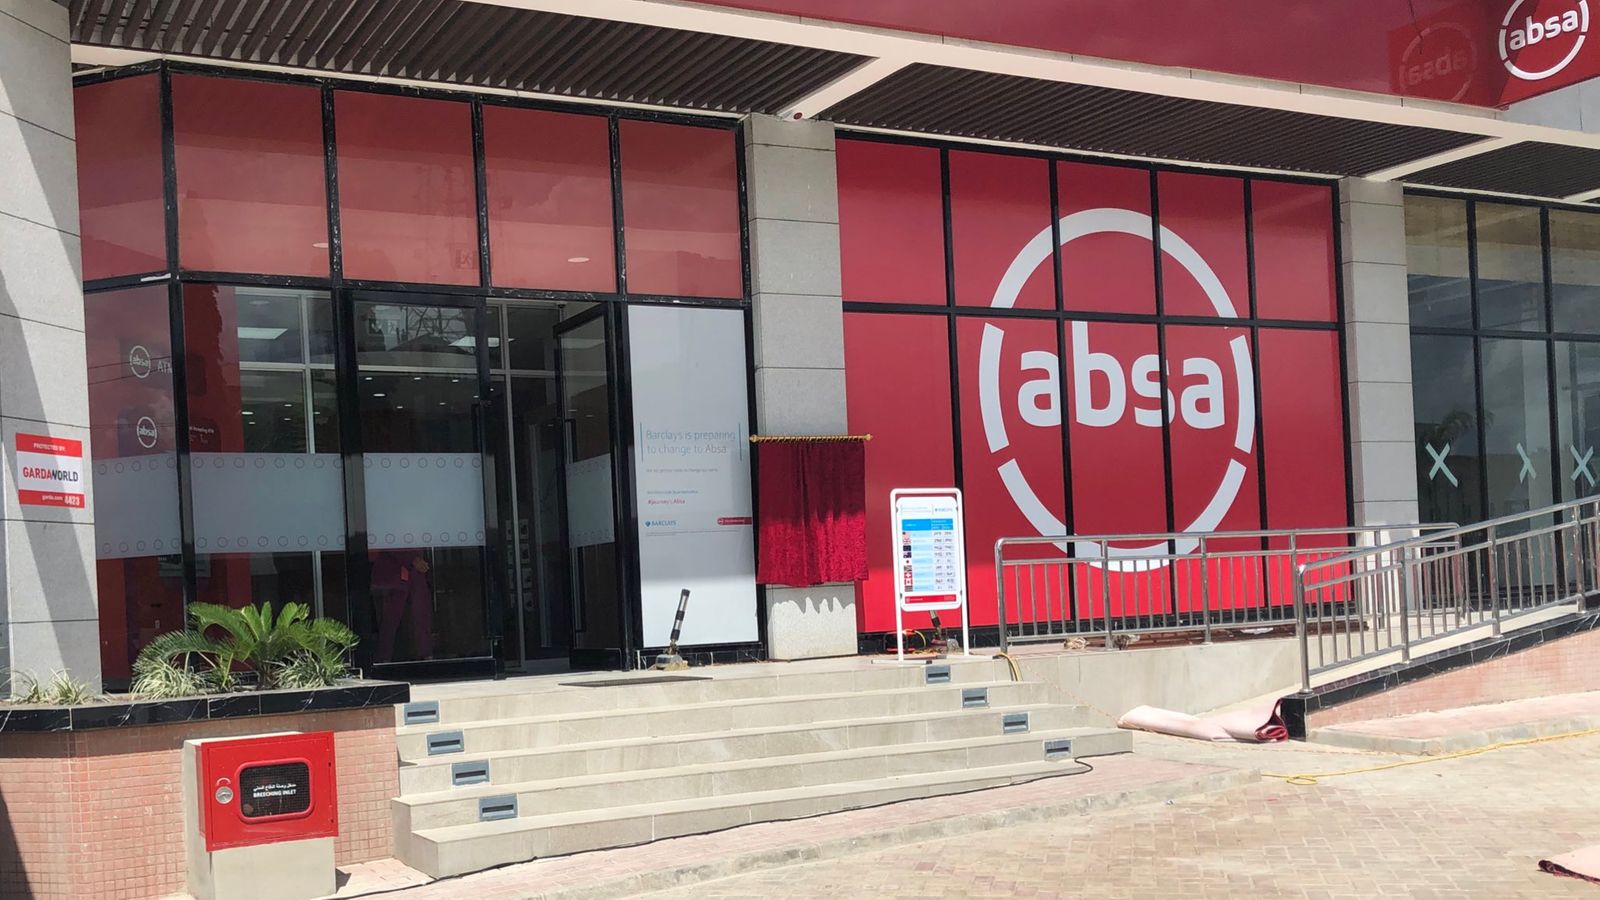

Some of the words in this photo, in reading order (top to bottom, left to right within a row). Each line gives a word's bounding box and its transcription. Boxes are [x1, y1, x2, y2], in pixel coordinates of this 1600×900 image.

[1510, 10, 1579, 50] absa
[1017, 320, 1226, 429] absa
[646, 430, 683, 441] Barclays
[684, 430, 693, 440] is
[694, 431, 736, 441] preparing
[647, 445, 656, 454] to
[658, 444, 692, 456] change
[694, 445, 703, 454] to
[704, 444, 727, 454] Absa
[22, 466, 79, 482] GARDAWORLD
[64, 495, 80, 506] 4423
